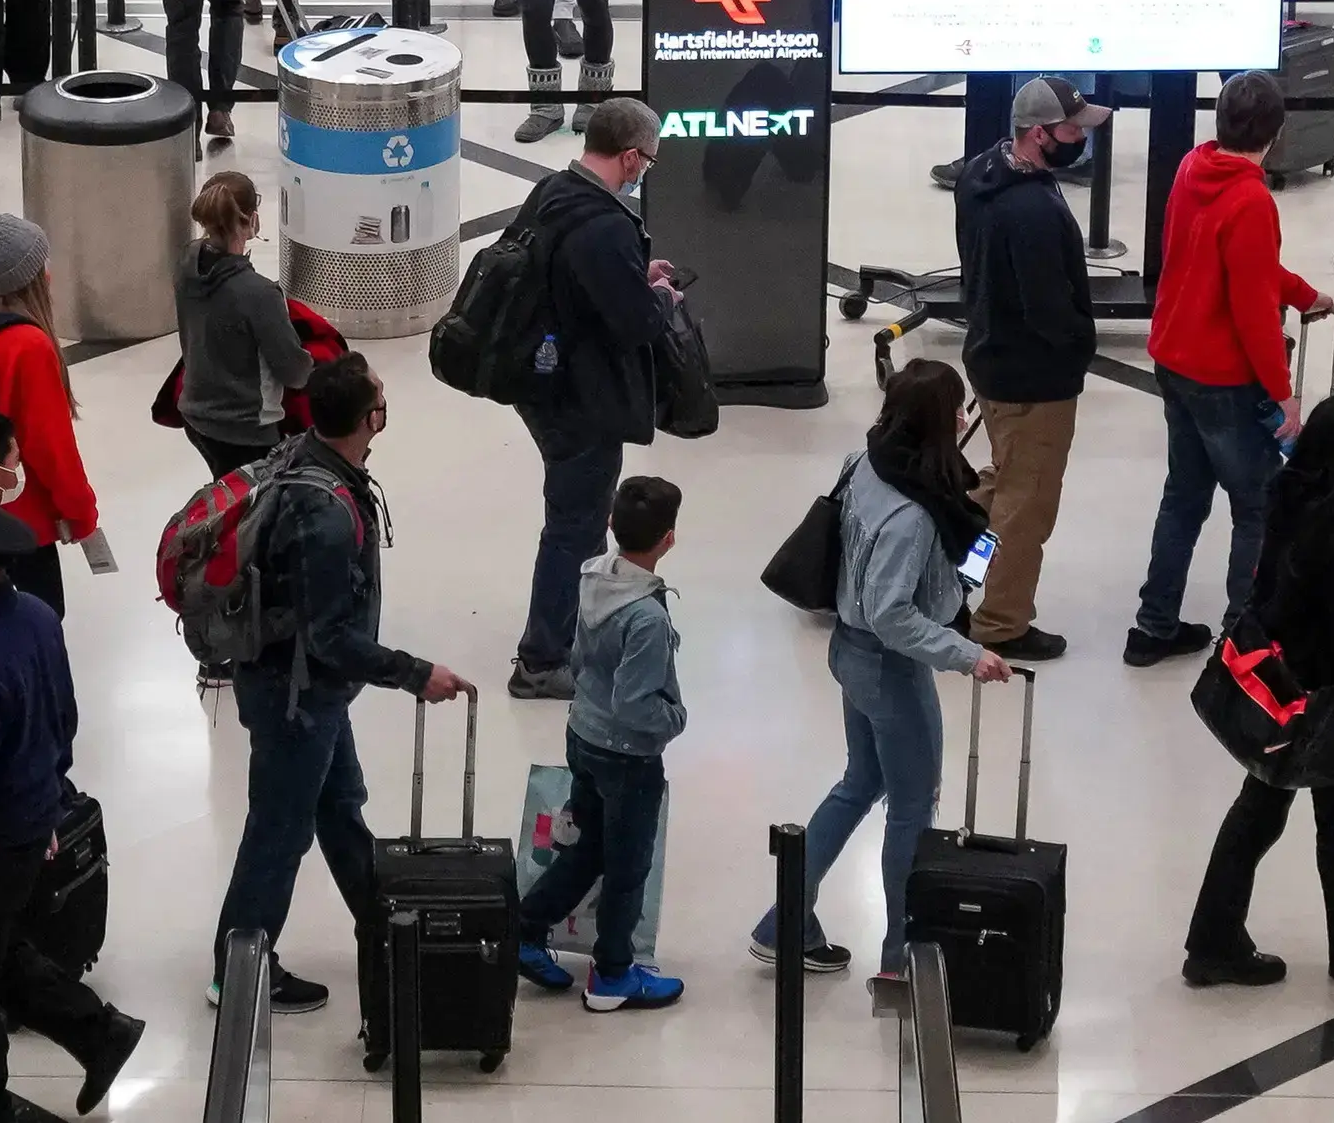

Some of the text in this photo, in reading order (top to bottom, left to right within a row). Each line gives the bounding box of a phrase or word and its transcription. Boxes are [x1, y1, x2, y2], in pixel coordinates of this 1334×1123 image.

[655, 30, 818, 49] Hartsfield-Jackson
[654, 49, 698, 61] Atlanta
[700, 48, 774, 60] International
